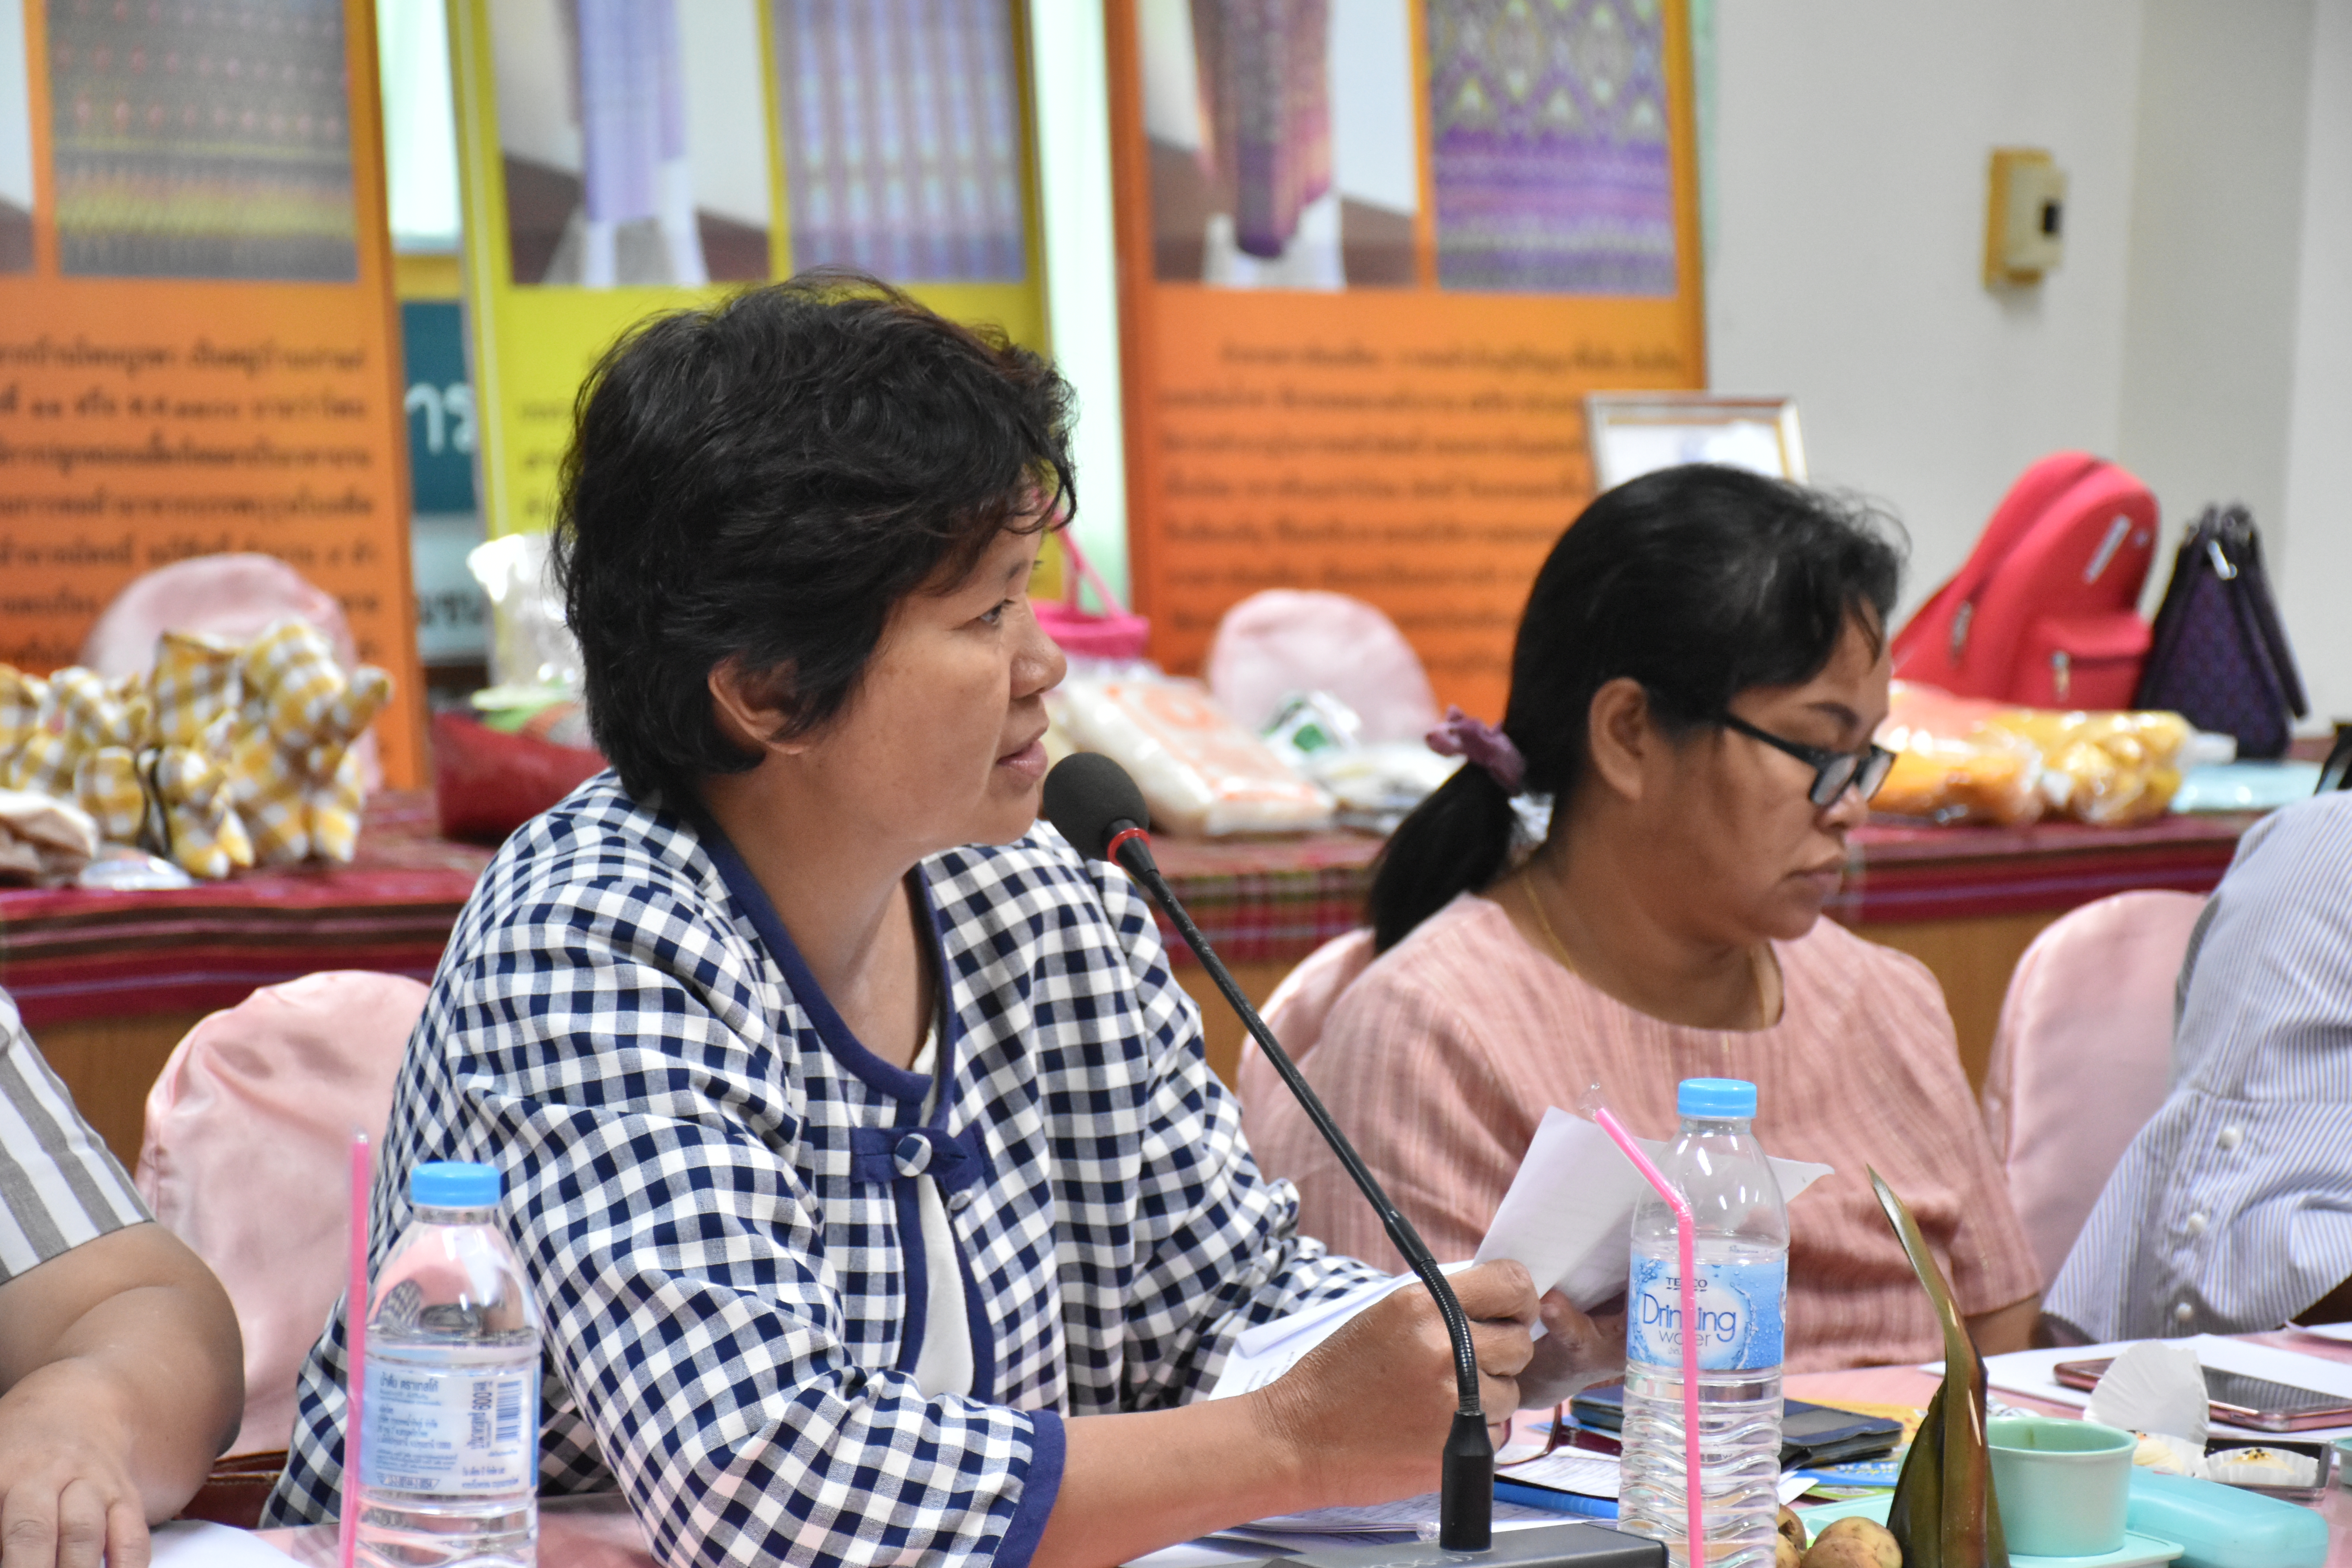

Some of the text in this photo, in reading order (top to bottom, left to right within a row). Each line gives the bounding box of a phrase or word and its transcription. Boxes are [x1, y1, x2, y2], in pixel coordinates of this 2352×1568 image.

[1666, 1277, 1708, 1288] TEO
[1643, 1293, 1737, 1343] Drining
[1659, 1330, 1711, 1347] waer
[472, 1392, 493, 1410] 600
